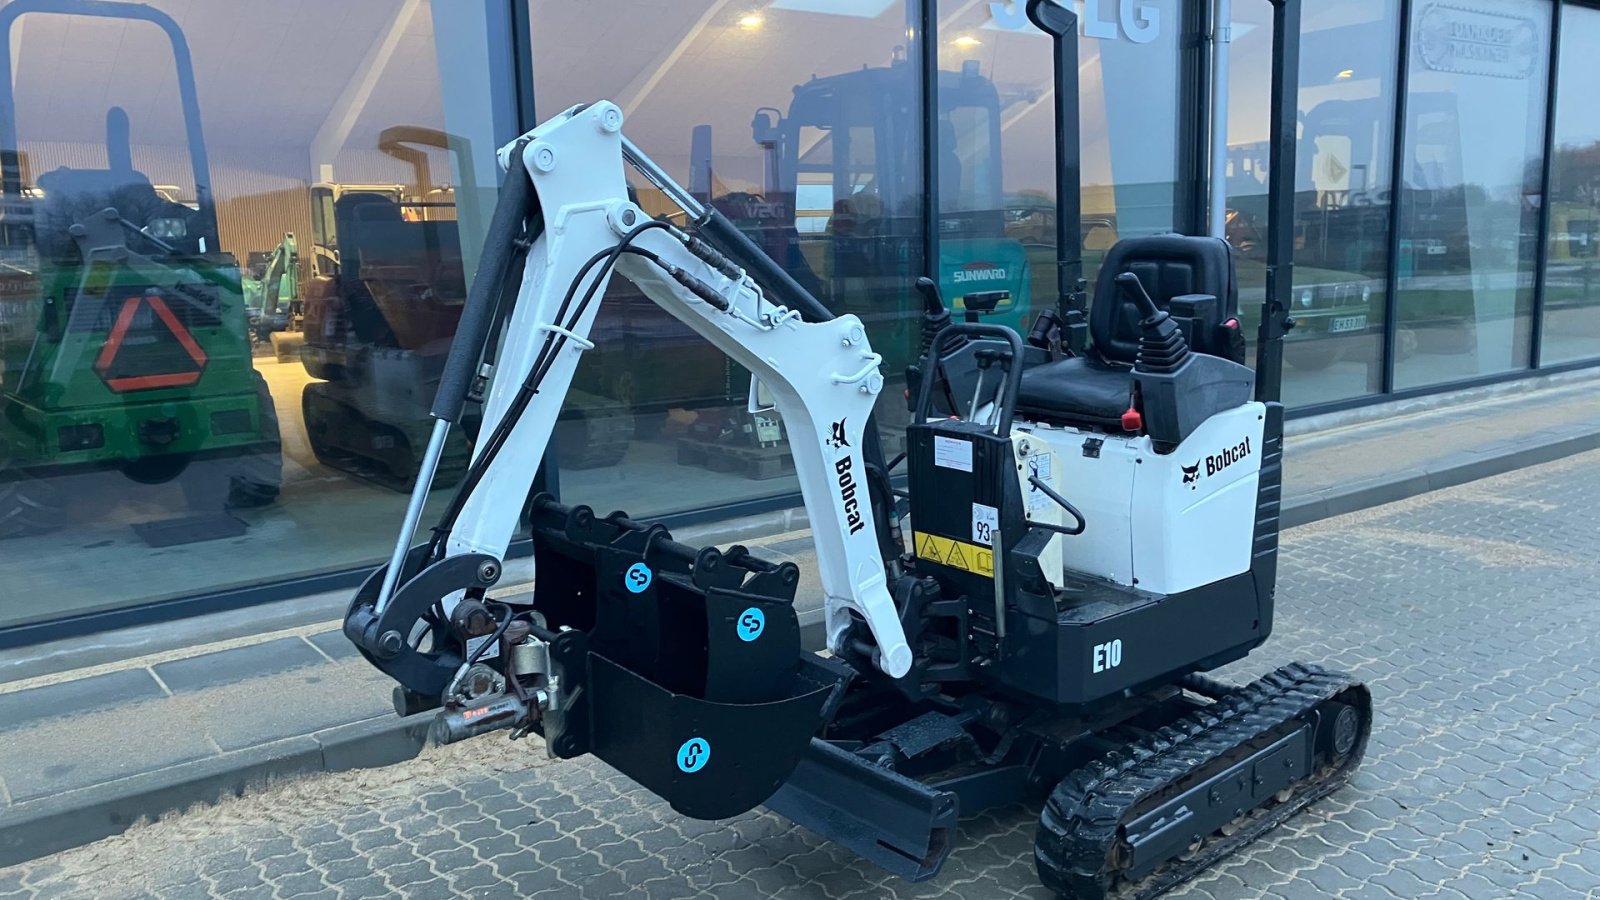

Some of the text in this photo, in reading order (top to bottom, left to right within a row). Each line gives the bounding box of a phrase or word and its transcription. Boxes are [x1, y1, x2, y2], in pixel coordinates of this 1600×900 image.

[990, 0, 1160, 43] LG
[953, 268, 1006, 282] SUNWARD
[1205, 435, 1251, 477] Bobcat
[835, 455, 865, 536] Bobcat
[976, 521, 990, 542] 93
[1093, 639, 1122, 674] E10
